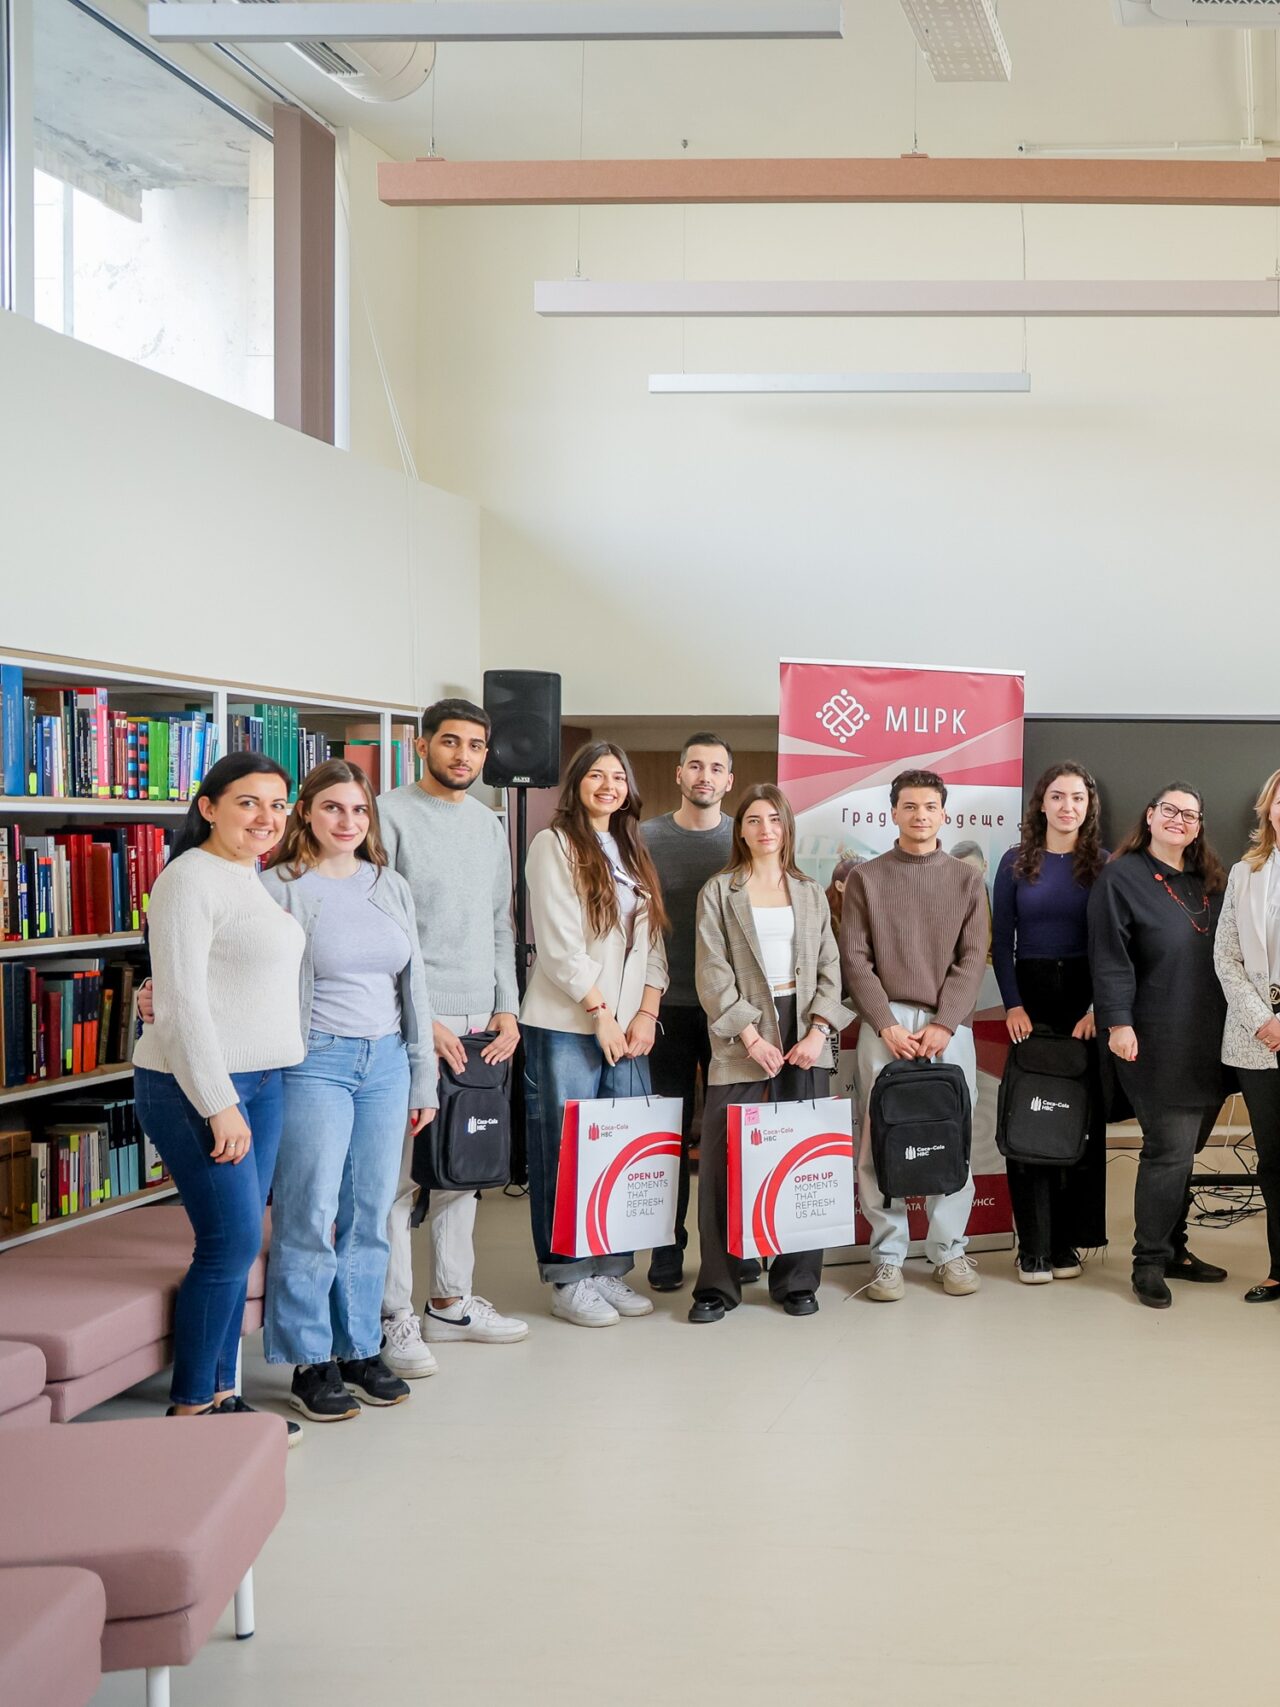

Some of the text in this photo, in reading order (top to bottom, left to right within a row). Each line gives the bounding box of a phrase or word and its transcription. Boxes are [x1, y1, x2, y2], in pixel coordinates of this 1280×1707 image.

[885, 706, 967, 734] МЦРК
[842, 808, 1004, 828] Град ъдеще
[628, 1171, 664, 1181] OPEN UP
[794, 1172, 833, 1183] OPEN UP
[628, 1180, 668, 1189] MOMENTS
[794, 1180, 838, 1192] MOMENTS
[628, 1190, 648, 1199] THAT
[795, 1191, 817, 1200] THAT
[627, 1198, 664, 1208] REFRESH
[796, 1198, 835, 1210] REFRESH
[626, 1208, 654, 1217] US ALL
[796, 1210, 807, 1219] US
